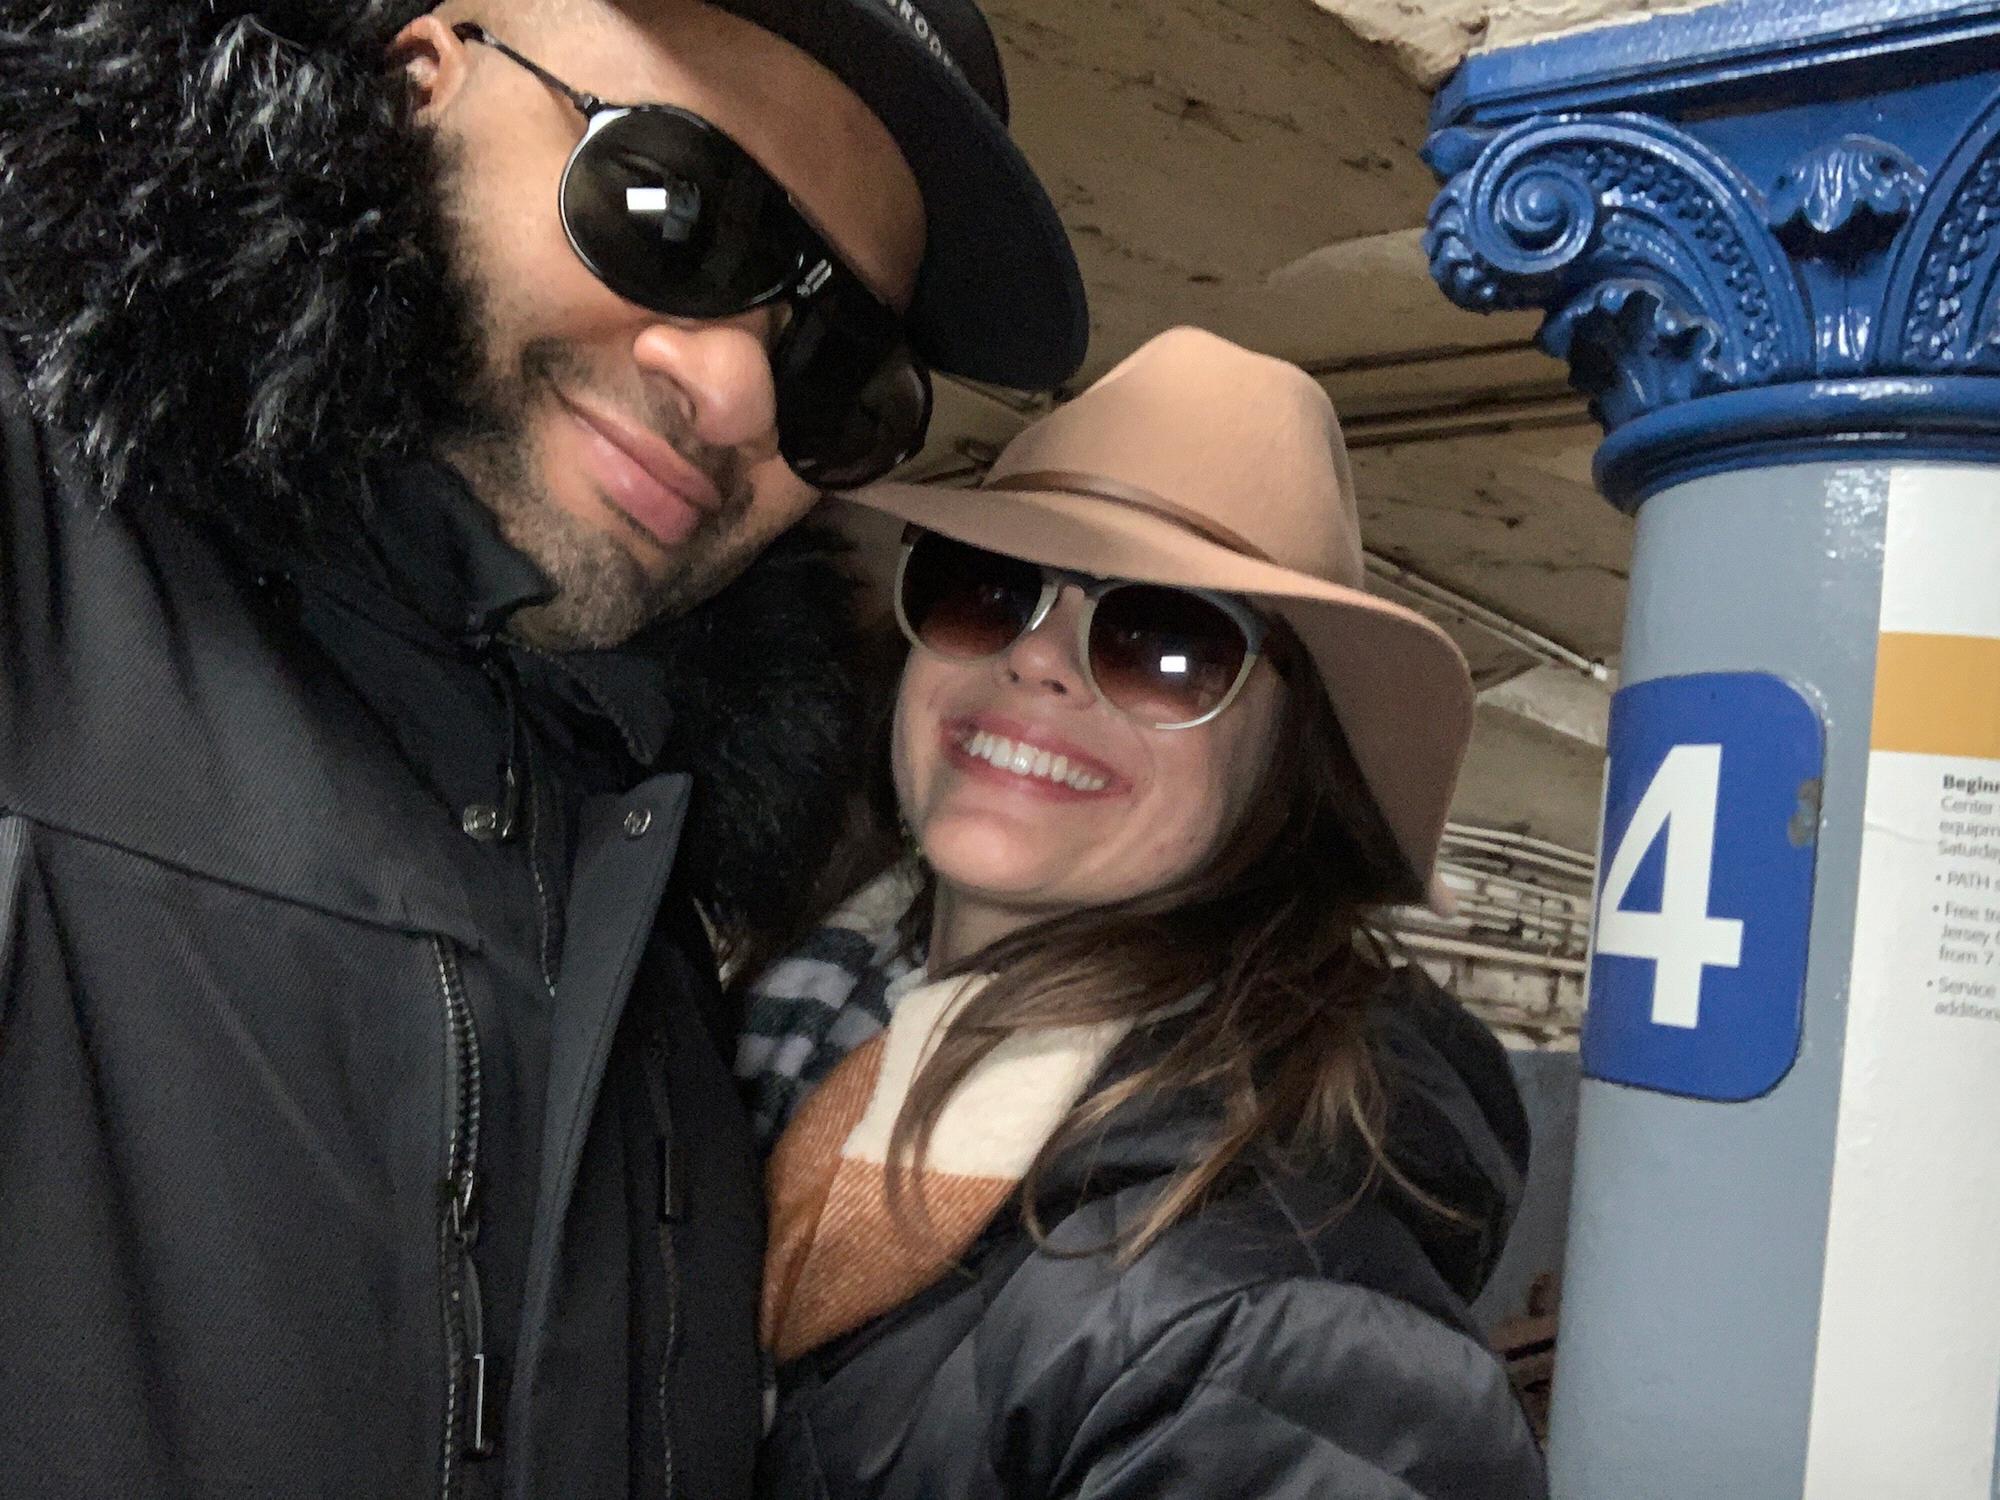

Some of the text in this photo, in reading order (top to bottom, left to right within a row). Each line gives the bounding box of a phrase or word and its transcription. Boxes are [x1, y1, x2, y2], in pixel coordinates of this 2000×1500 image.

[1597, 744, 1743, 1030] 4
[1947, 871, 1990, 889] PATH
[1945, 900, 1979, 921] Free
[1941, 923, 1990, 947] Jersey
[1939, 943, 1977, 964] from
[1939, 976, 1996, 1000] Service
